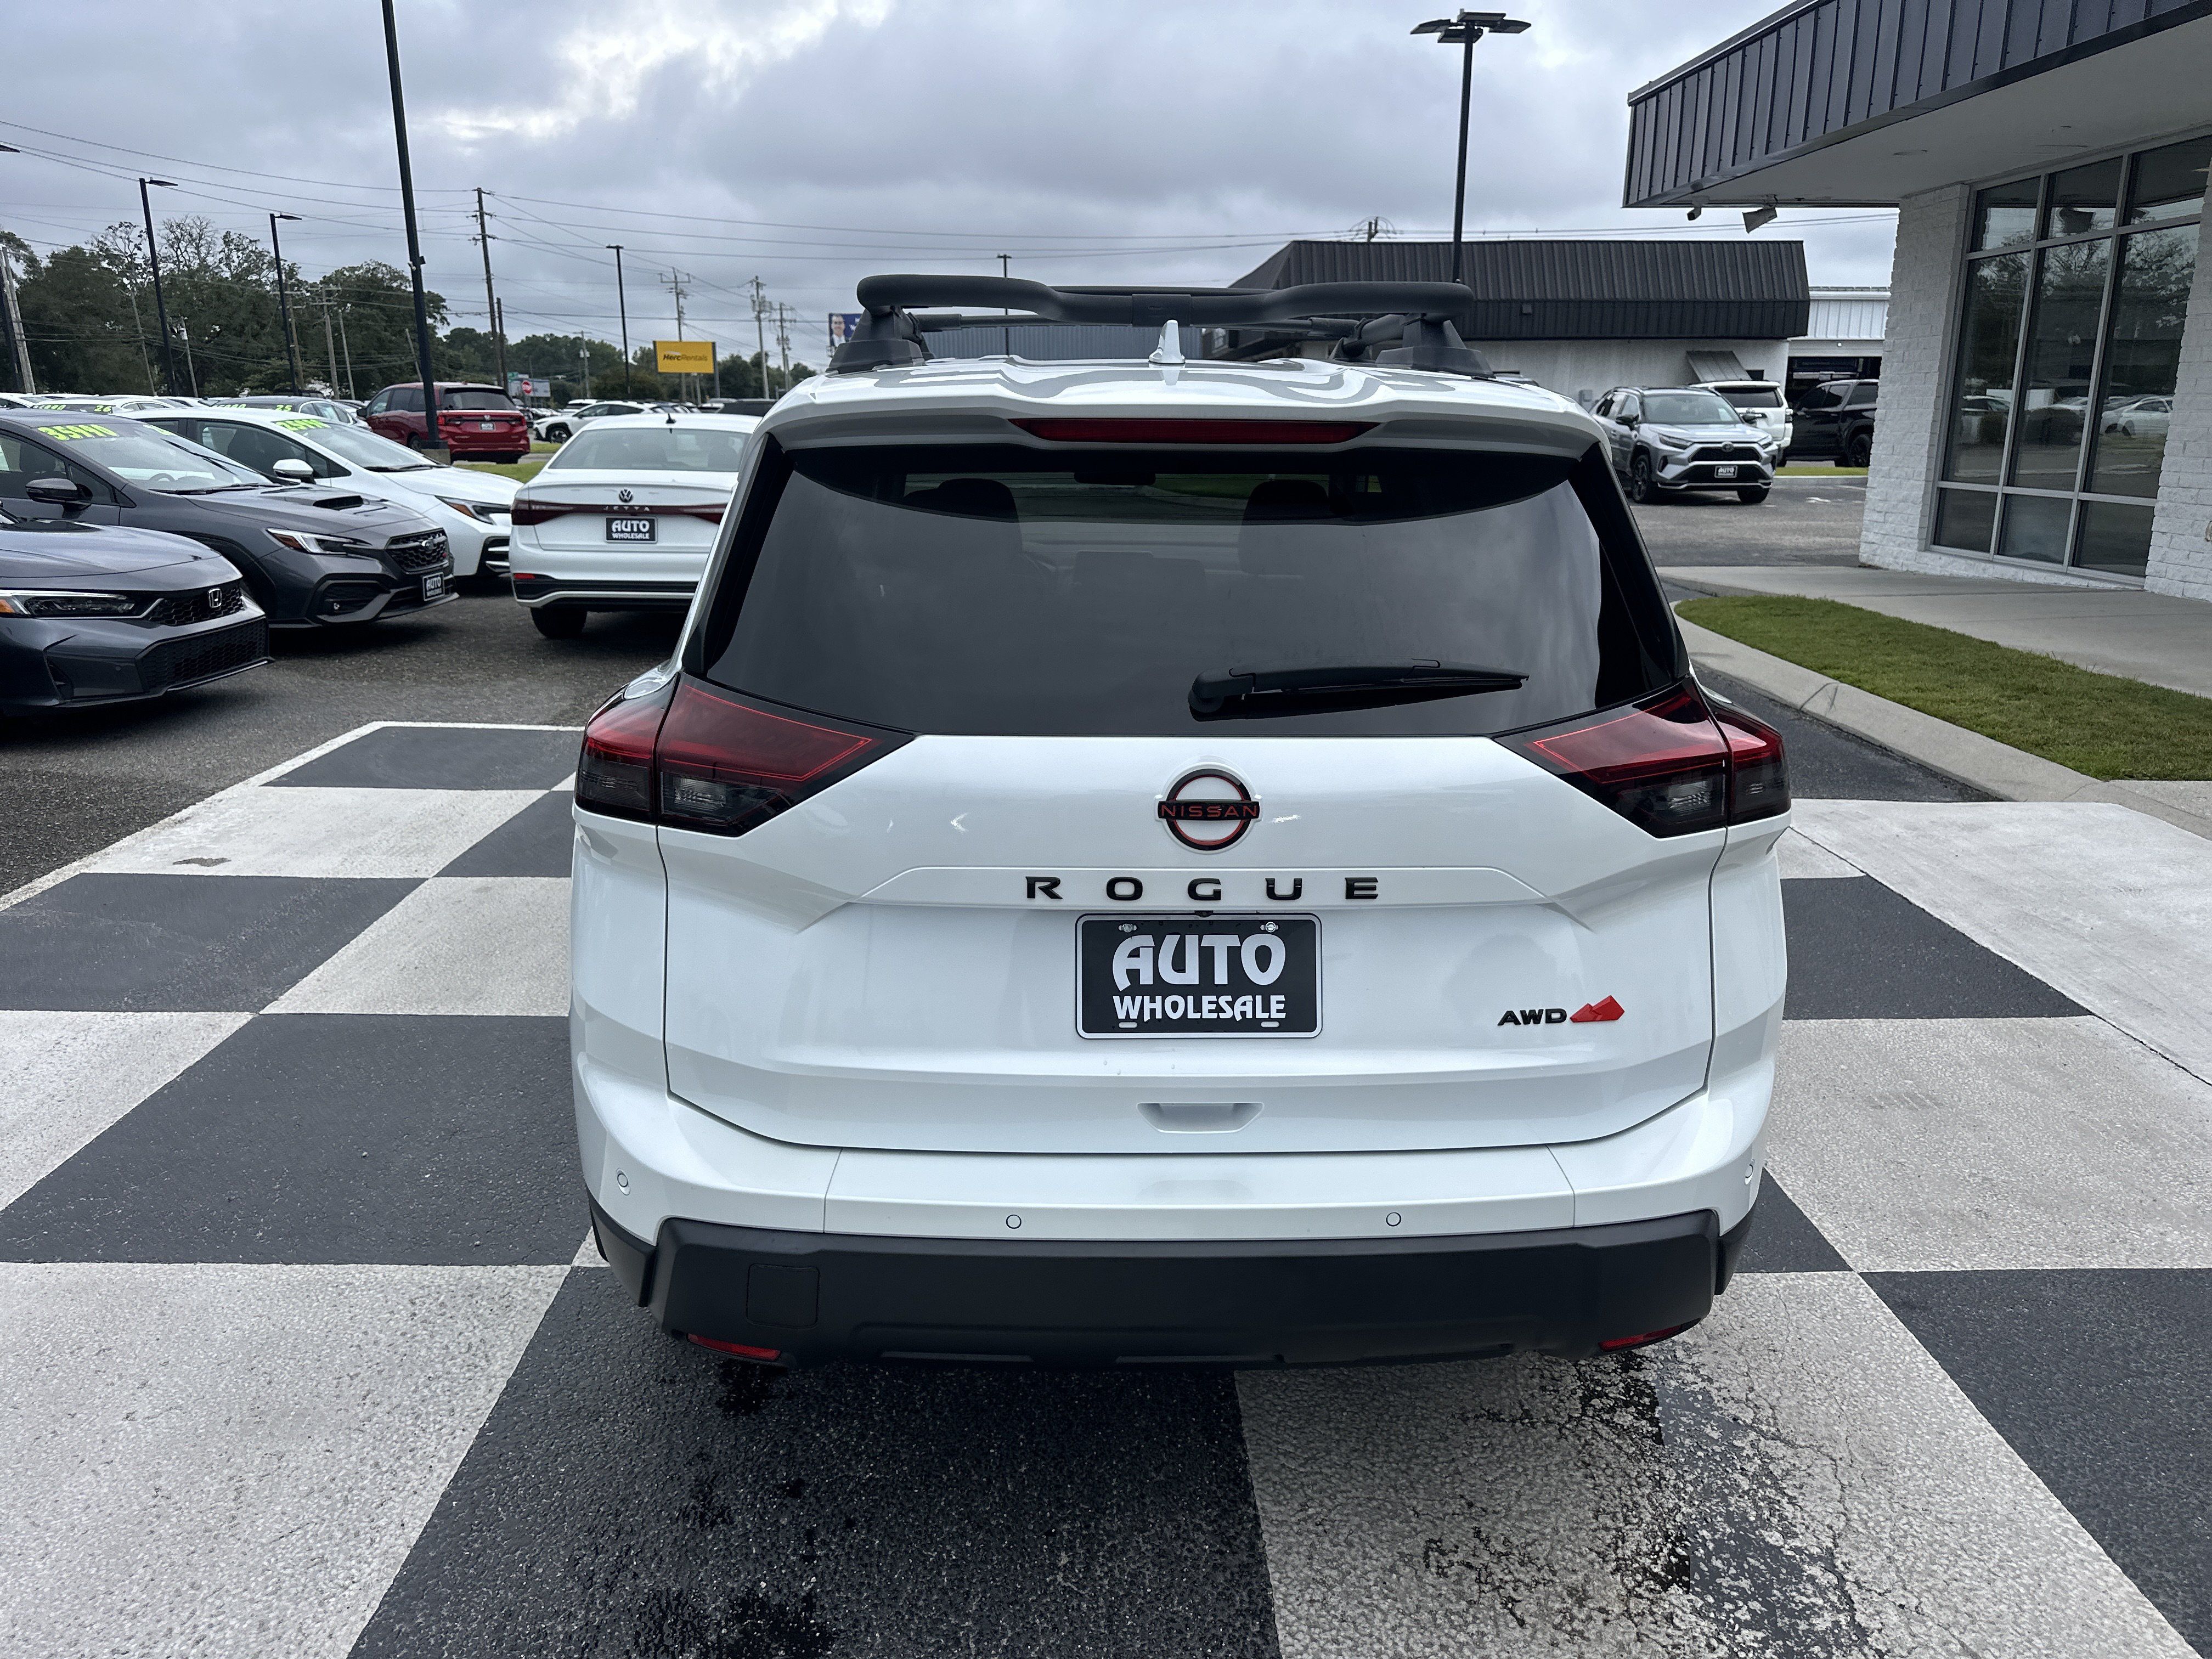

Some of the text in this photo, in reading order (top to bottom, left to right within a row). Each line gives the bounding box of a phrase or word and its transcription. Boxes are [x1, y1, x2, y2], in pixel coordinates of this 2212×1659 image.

[612, 520, 650, 532] AUTO
[426, 577, 441, 591] AUTO
[1161, 805, 1257, 817] NISSAN
[1025, 876, 1379, 901] ROGUE
[1112, 933, 1286, 991] AUTO
[1112, 995, 1286, 1022] WHOLESALE
[1497, 1008, 1567, 1026] AWD
